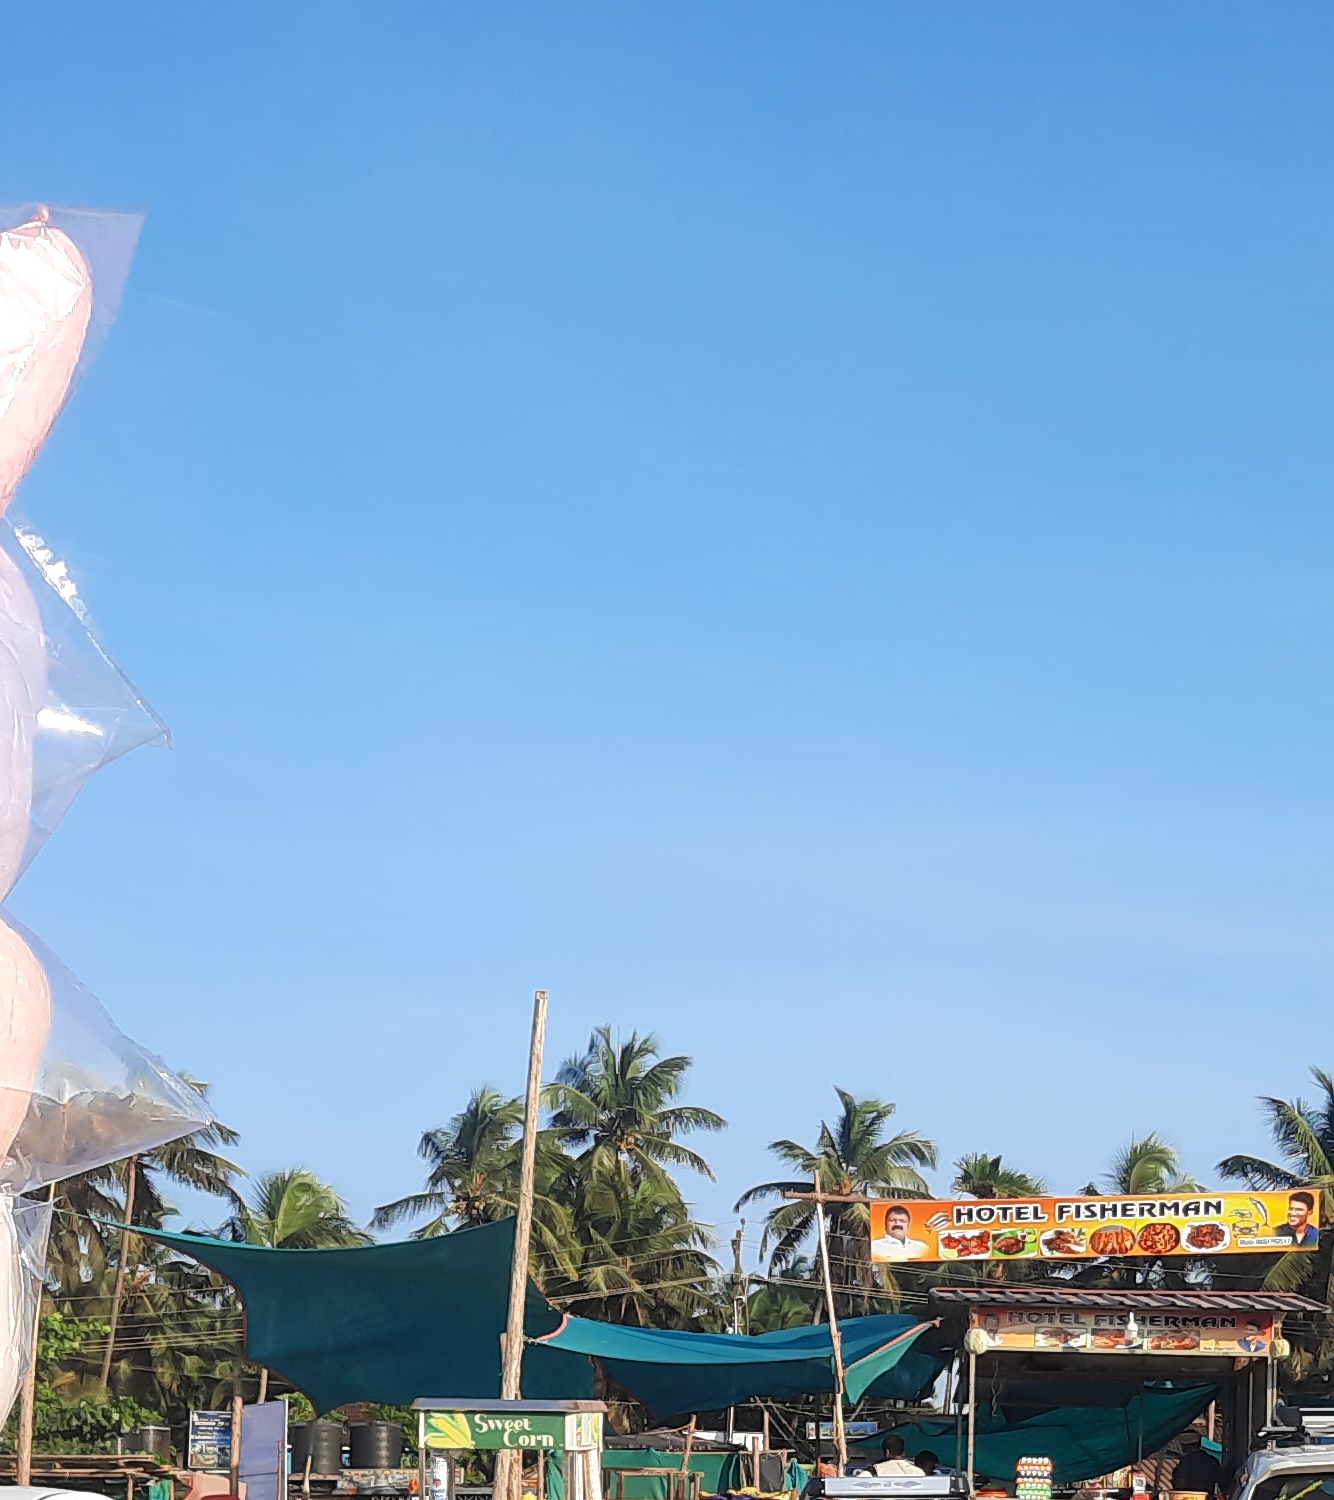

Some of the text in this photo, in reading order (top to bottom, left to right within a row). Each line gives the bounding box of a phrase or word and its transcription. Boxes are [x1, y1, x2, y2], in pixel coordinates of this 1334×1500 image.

[955, 1200, 1223, 1224] HOTEL FISHERMAN
[1007, 1311, 1237, 1328] HOTEL FISHERMAN
[474, 1414, 533, 1433] Sweet
[503, 1430, 554, 1448] Corn
